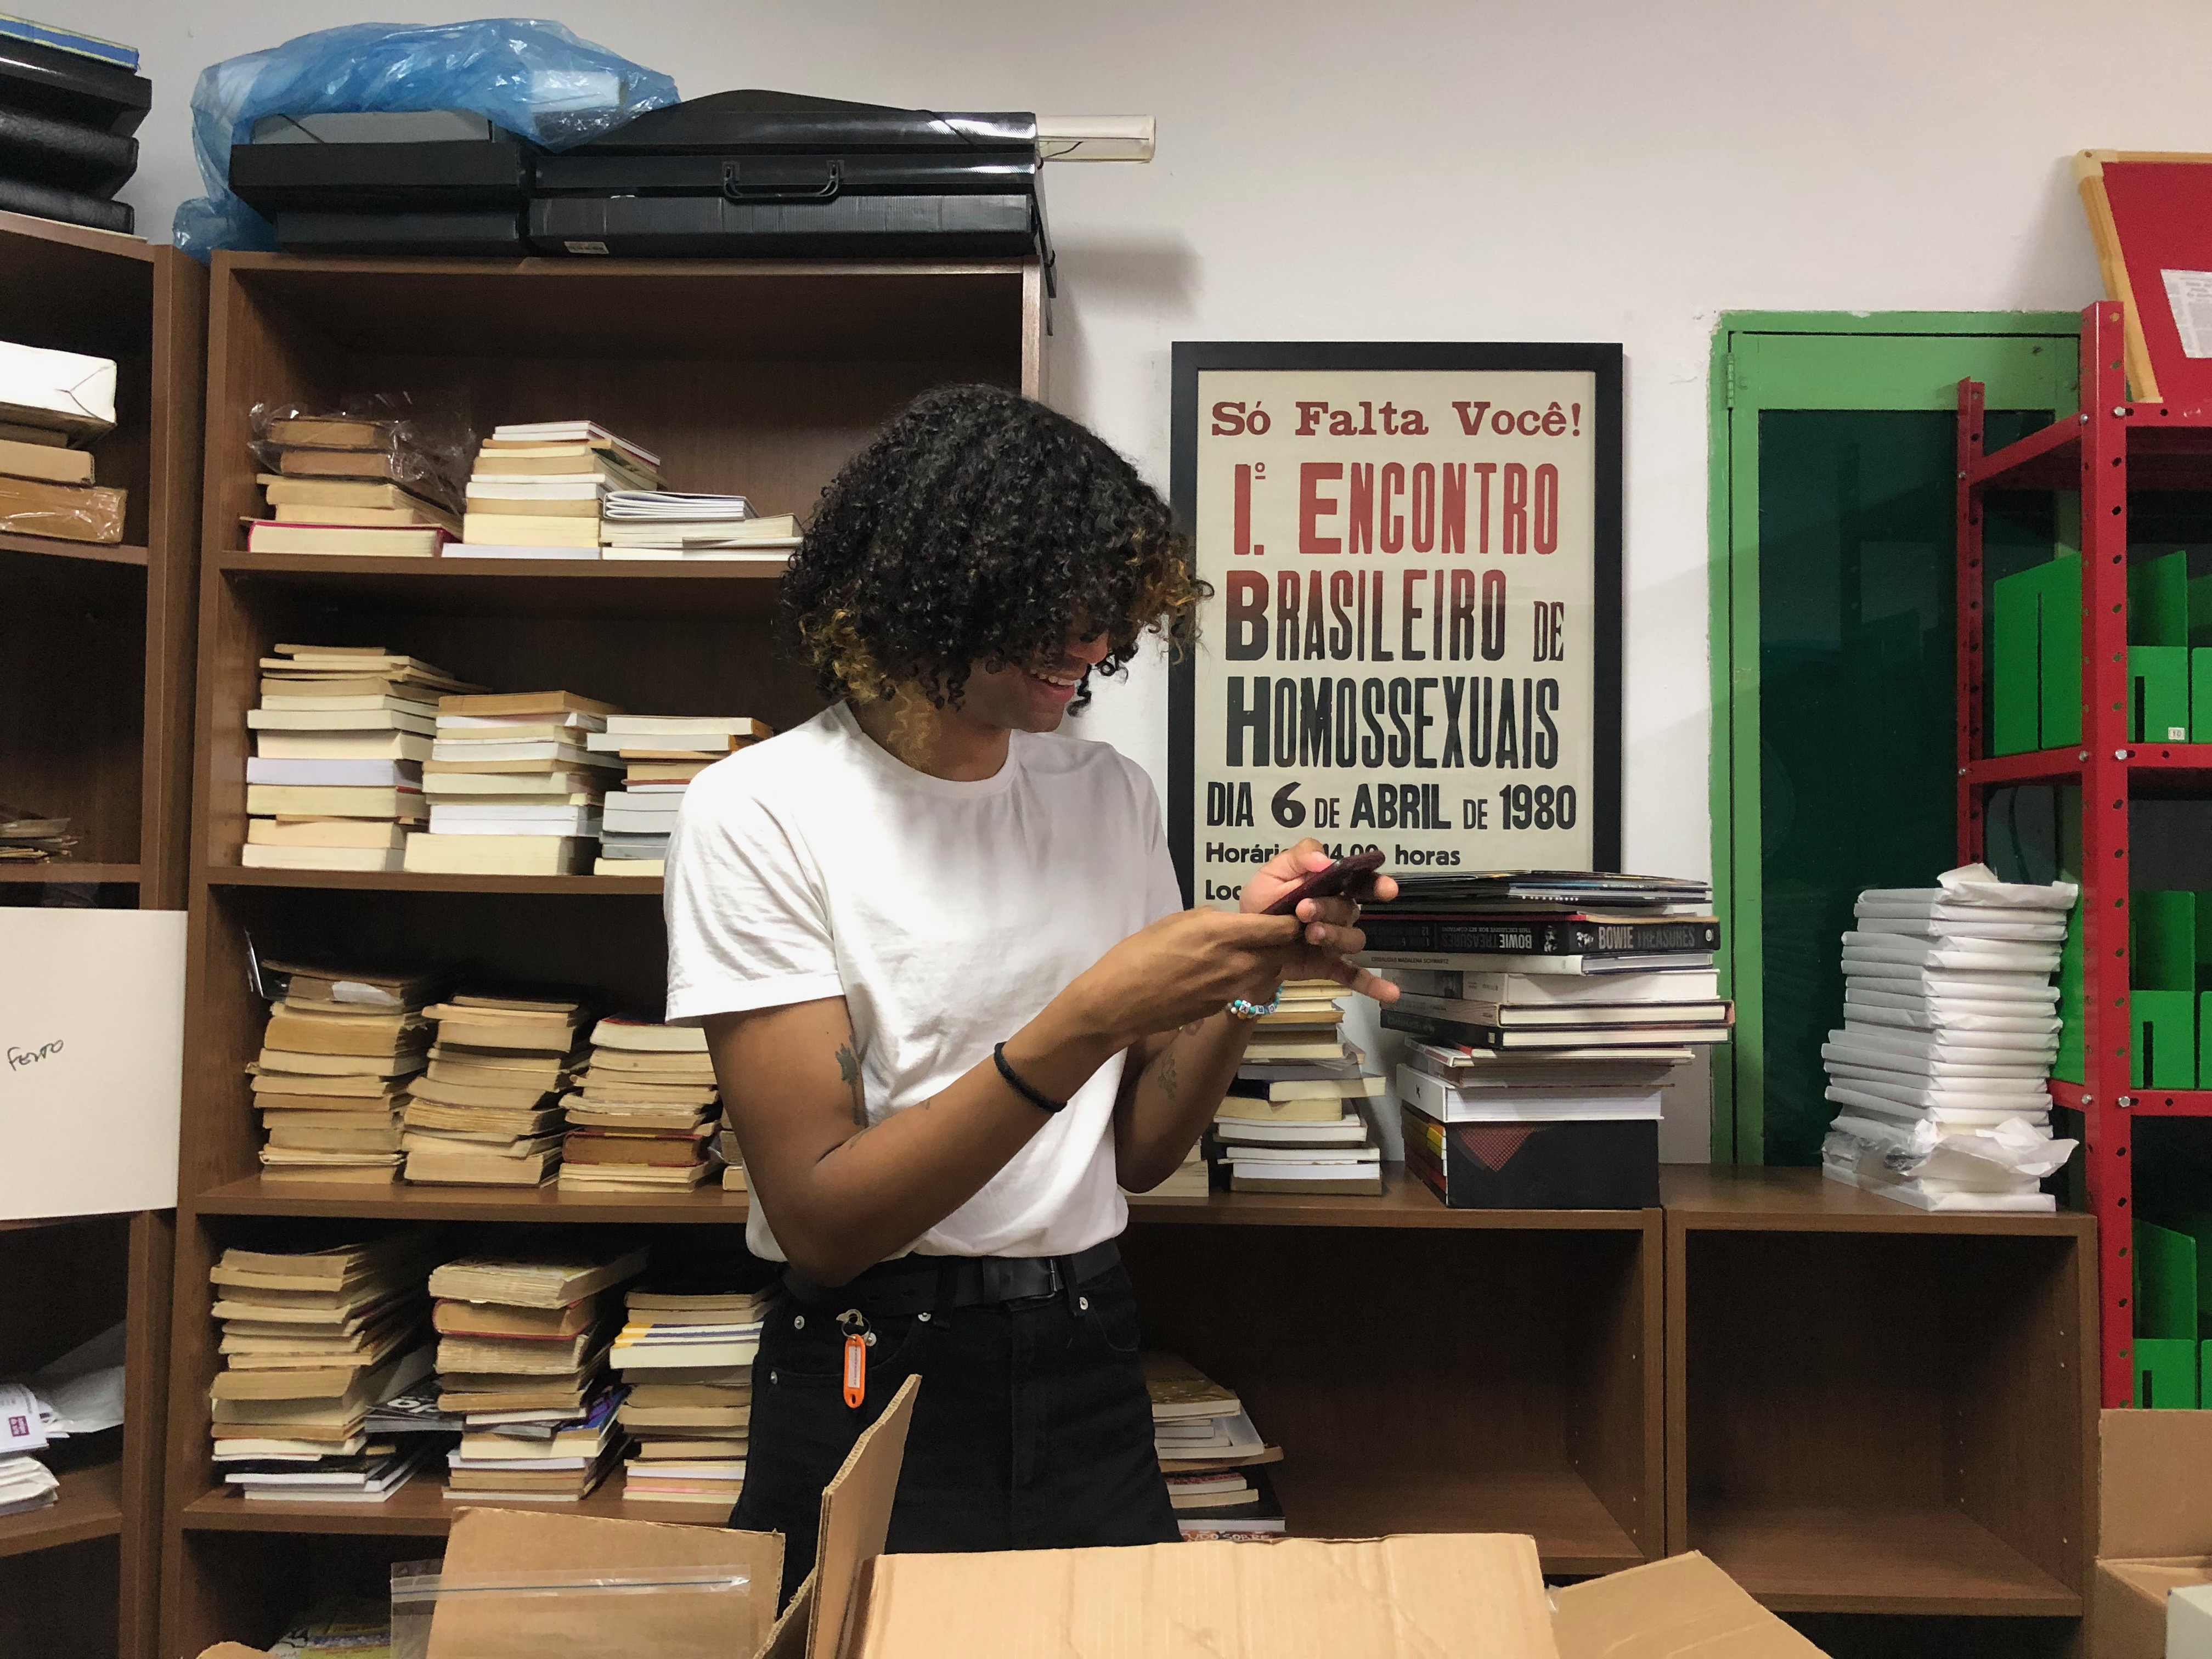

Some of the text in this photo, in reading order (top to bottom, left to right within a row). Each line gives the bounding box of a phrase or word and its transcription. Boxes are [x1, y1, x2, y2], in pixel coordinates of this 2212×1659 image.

[1211, 400, 1581, 437] Só Falta Você!
[1299, 462, 1559, 555] ENCONTRO
[1225, 569, 1564, 662] BRASILEIRO DE
[1226, 676, 1560, 770] HOMOSSEXUAIS
[1206, 781, 1577, 830] DIA 6 DE ABRIL DE 1980
[1395, 844, 1461, 866] horas
[1441, 933, 1498, 948] TREASURES
[1499, 933, 1532, 949] BOWIE
[1598, 926, 1695, 950] BOWIE TREASURES
